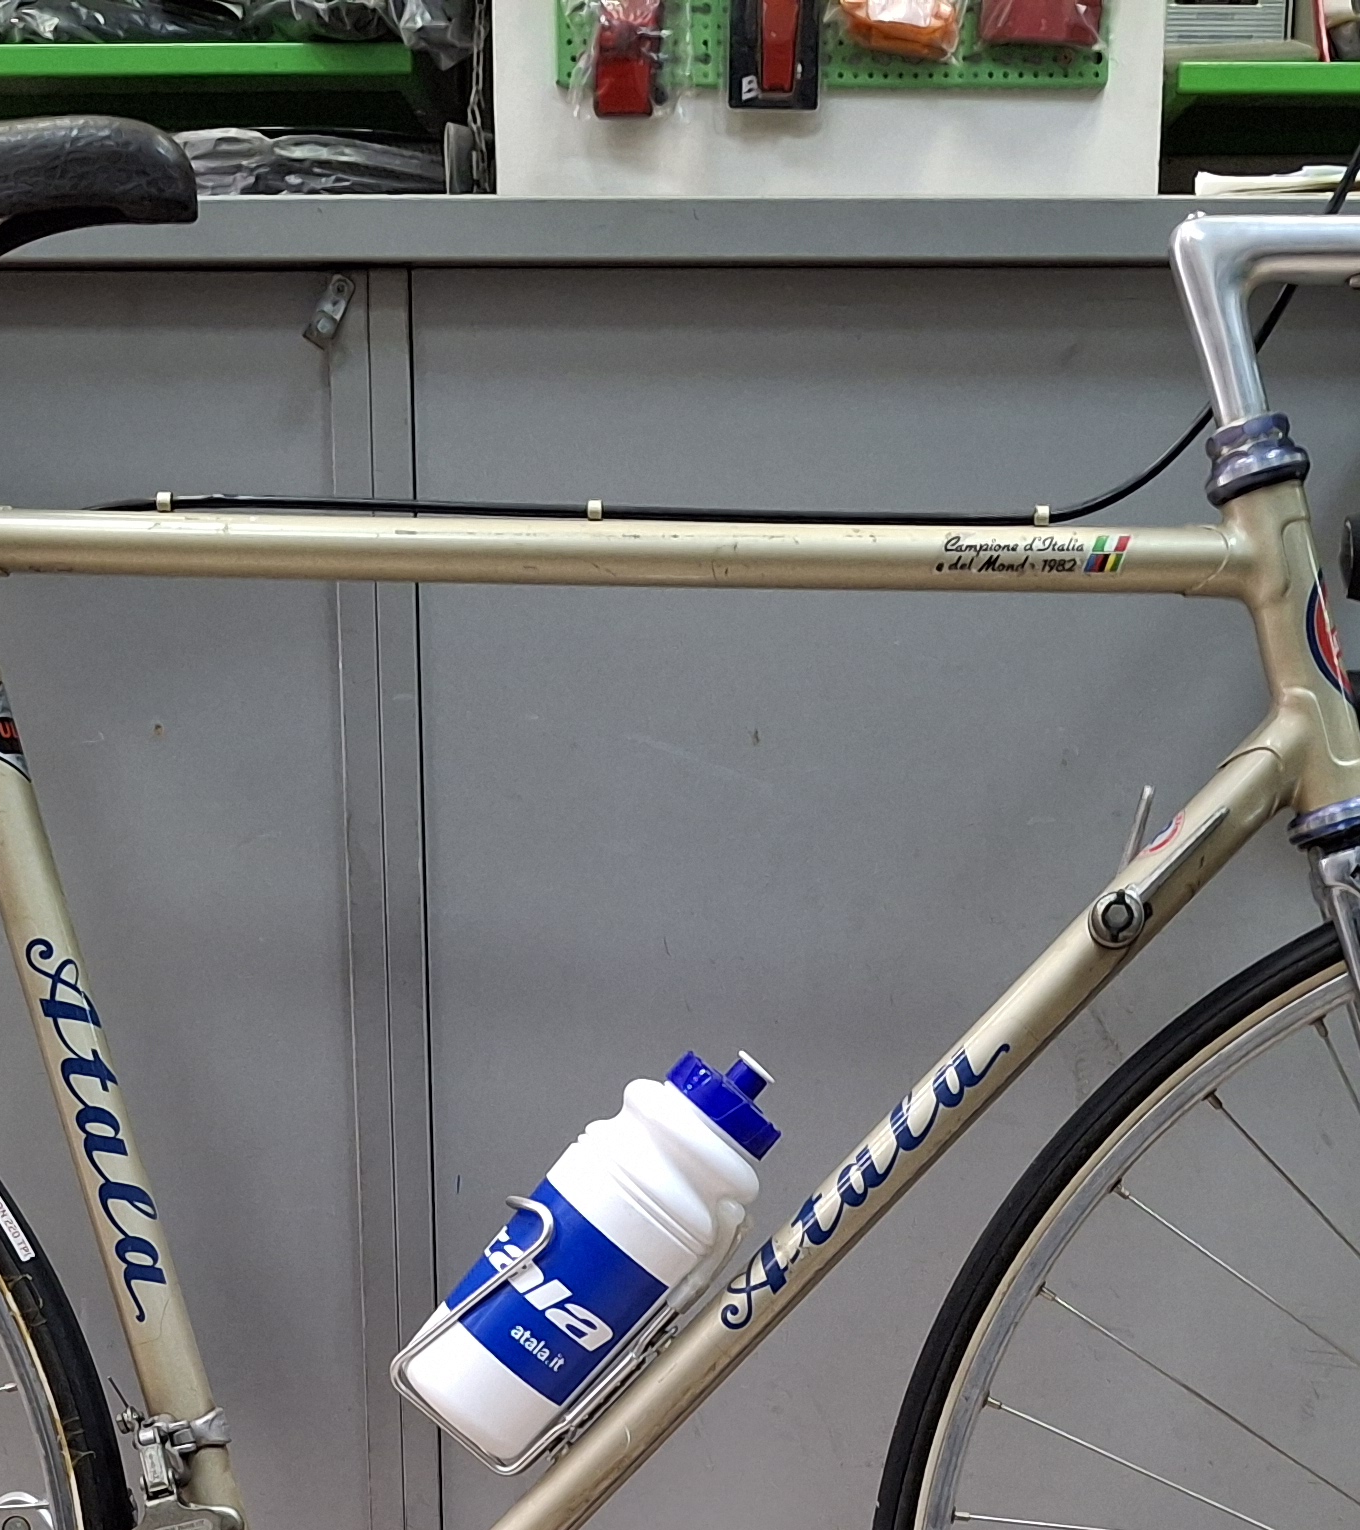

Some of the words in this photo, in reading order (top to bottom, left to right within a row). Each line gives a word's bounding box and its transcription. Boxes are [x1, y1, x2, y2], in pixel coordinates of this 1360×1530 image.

[944, 535, 1019, 559] Campione
[1023, 536, 1085, 553] d'Italia
[947, 554, 975, 571] del
[1041, 557, 1078, 573] 1982
[25, 937, 168, 1323] Atala
[720, 1042, 1011, 1330] Atala
[510, 1324, 566, 1373] atala.it
